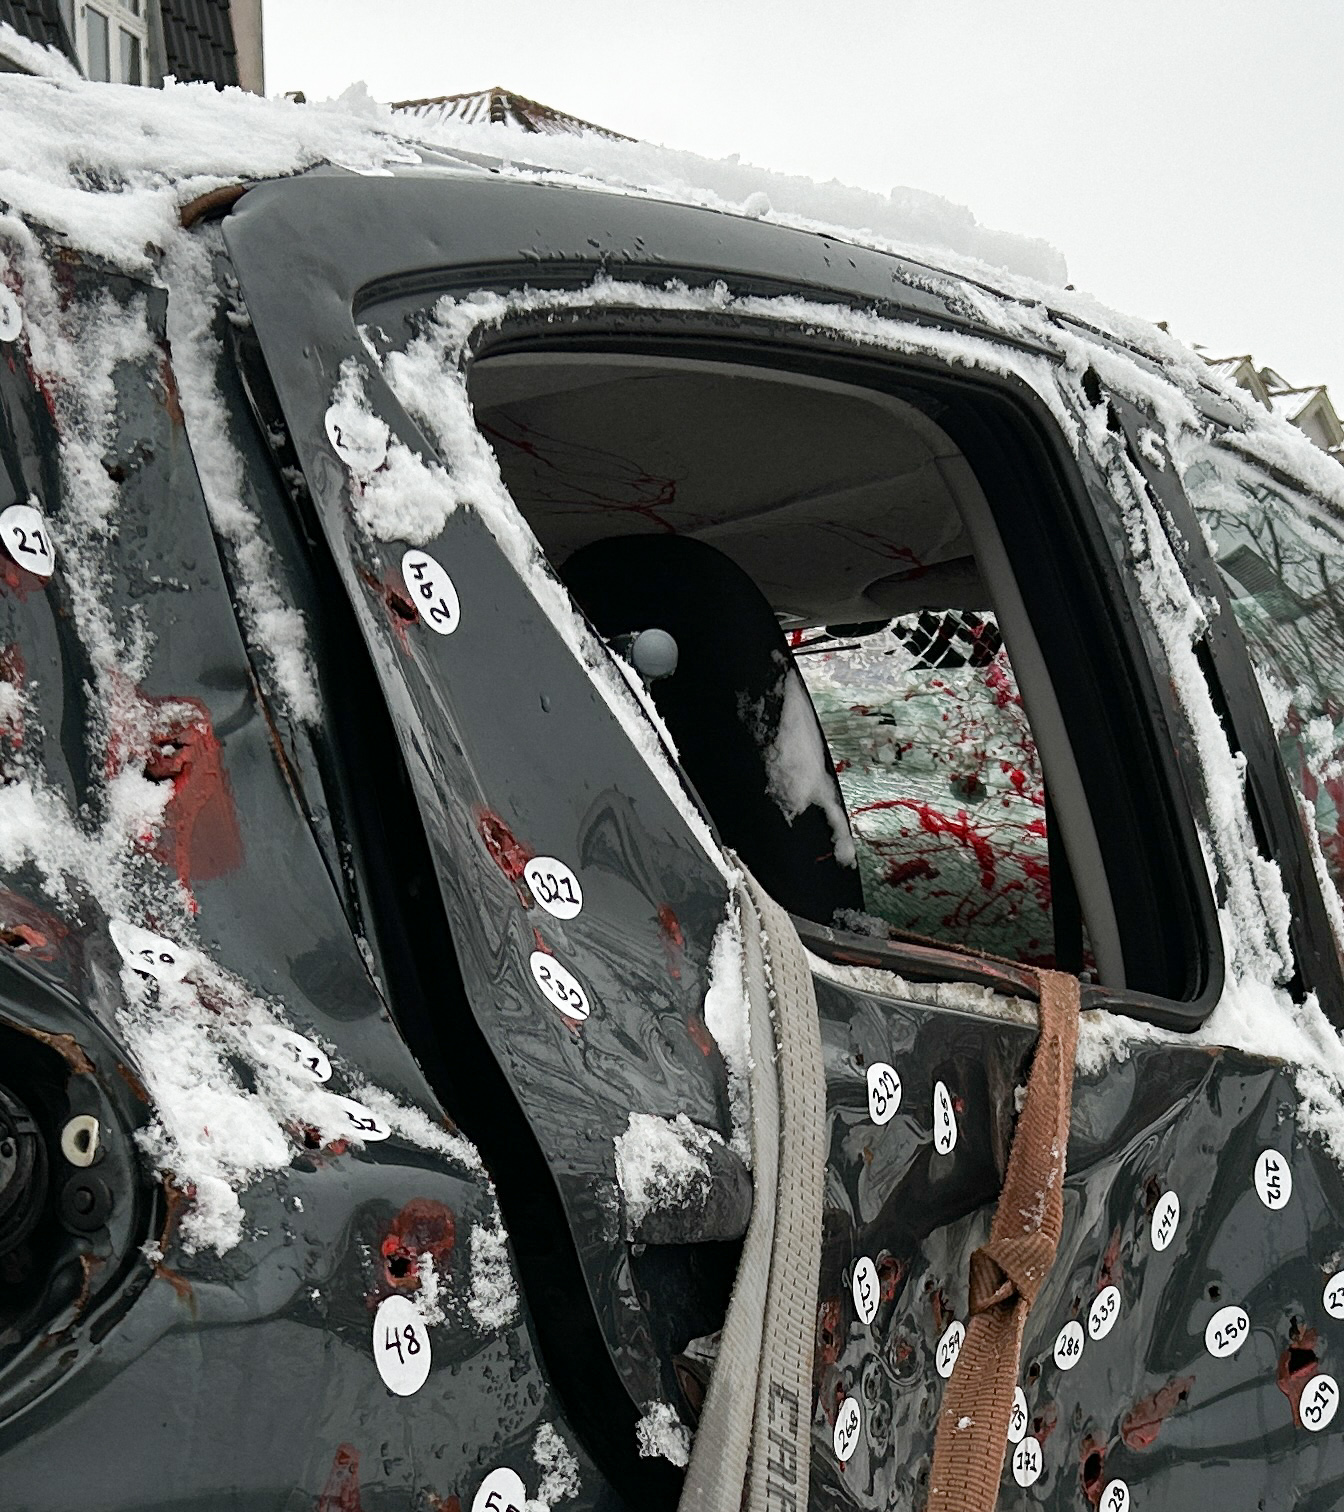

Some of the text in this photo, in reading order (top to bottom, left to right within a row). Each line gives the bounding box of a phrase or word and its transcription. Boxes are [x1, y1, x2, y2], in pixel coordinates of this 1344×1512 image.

[409, 562, 450, 624] 294
[532, 871, 579, 904] 321
[540, 966, 586, 1015] 232
[873, 1071, 900, 1117] 322
[1265, 1158, 1281, 1204] 242
[1158, 1205, 1176, 1245] 241
[1092, 1293, 1114, 1333] 335
[1215, 1316, 1249, 1350] 250
[386, 1324, 420, 1364] 48
[942, 1330, 961, 1369] 259
[1058, 1335, 1079, 1356] 286
[1305, 1381, 1334, 1423] 319
[839, 1410, 858, 1455] 268
